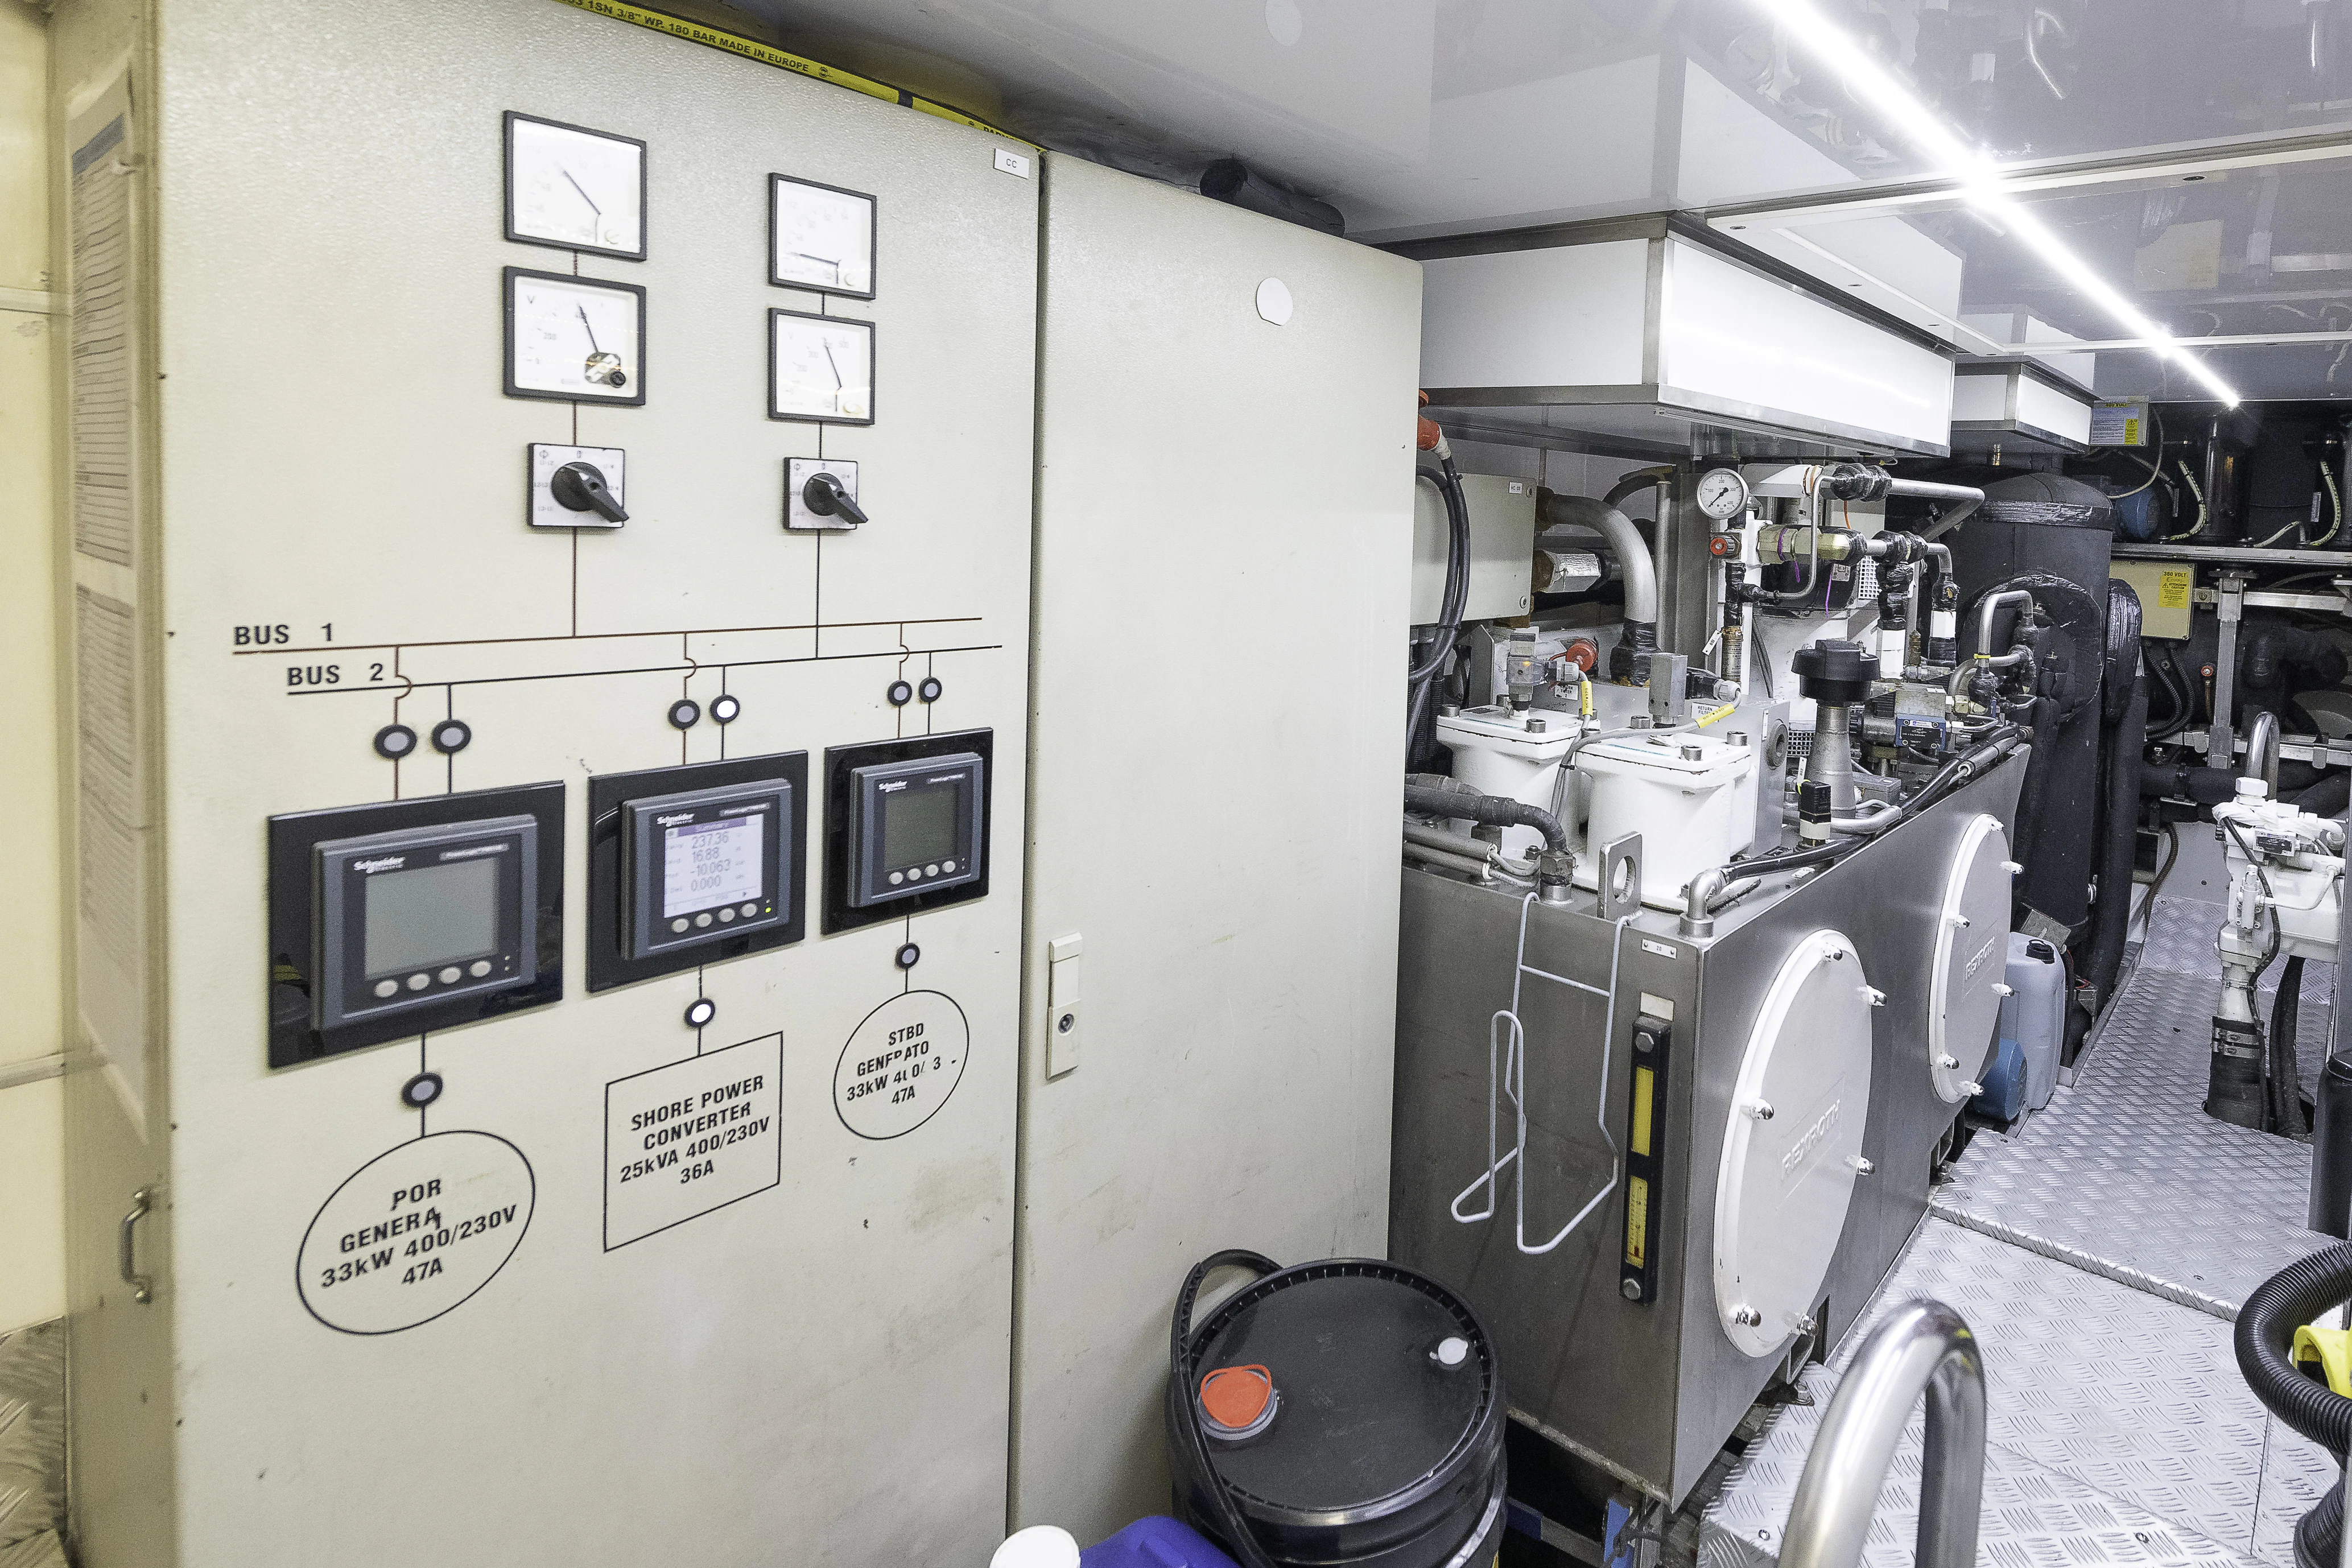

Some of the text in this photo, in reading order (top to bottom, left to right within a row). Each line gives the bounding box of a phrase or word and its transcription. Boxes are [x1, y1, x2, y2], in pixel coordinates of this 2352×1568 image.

[669, 23, 690, 35] 180
[693, 30, 717, 44] BAR
[720, 38, 750, 55] MADE
[753, 48, 765, 58] IN
[768, 51, 809, 72] EUROPE
[1005, 158, 1017, 168] CC
[527, 295, 535, 304] V
[233, 623, 333, 646] BUS 1
[287, 663, 384, 686] BUS 2
[657, 813, 695, 824] Schneider
[353, 856, 406, 870] Schneider
[888, 1022, 924, 1046] STBD
[847, 1074, 888, 1101] 33kW
[891, 1085, 915, 1105] 47A
[631, 1075, 764, 1132] SHORE POWER
[644, 1101, 751, 1151] CONVERTER
[620, 1116, 770, 1185] 25kVA 400/230V
[1781, 1099, 1841, 1181] REXROTH
[680, 1159, 715, 1185] 36A
[390, 1178, 441, 1212] POR
[321, 1204, 517, 1289] 33kW 400/230V
[401, 1257, 444, 1285] 47A
